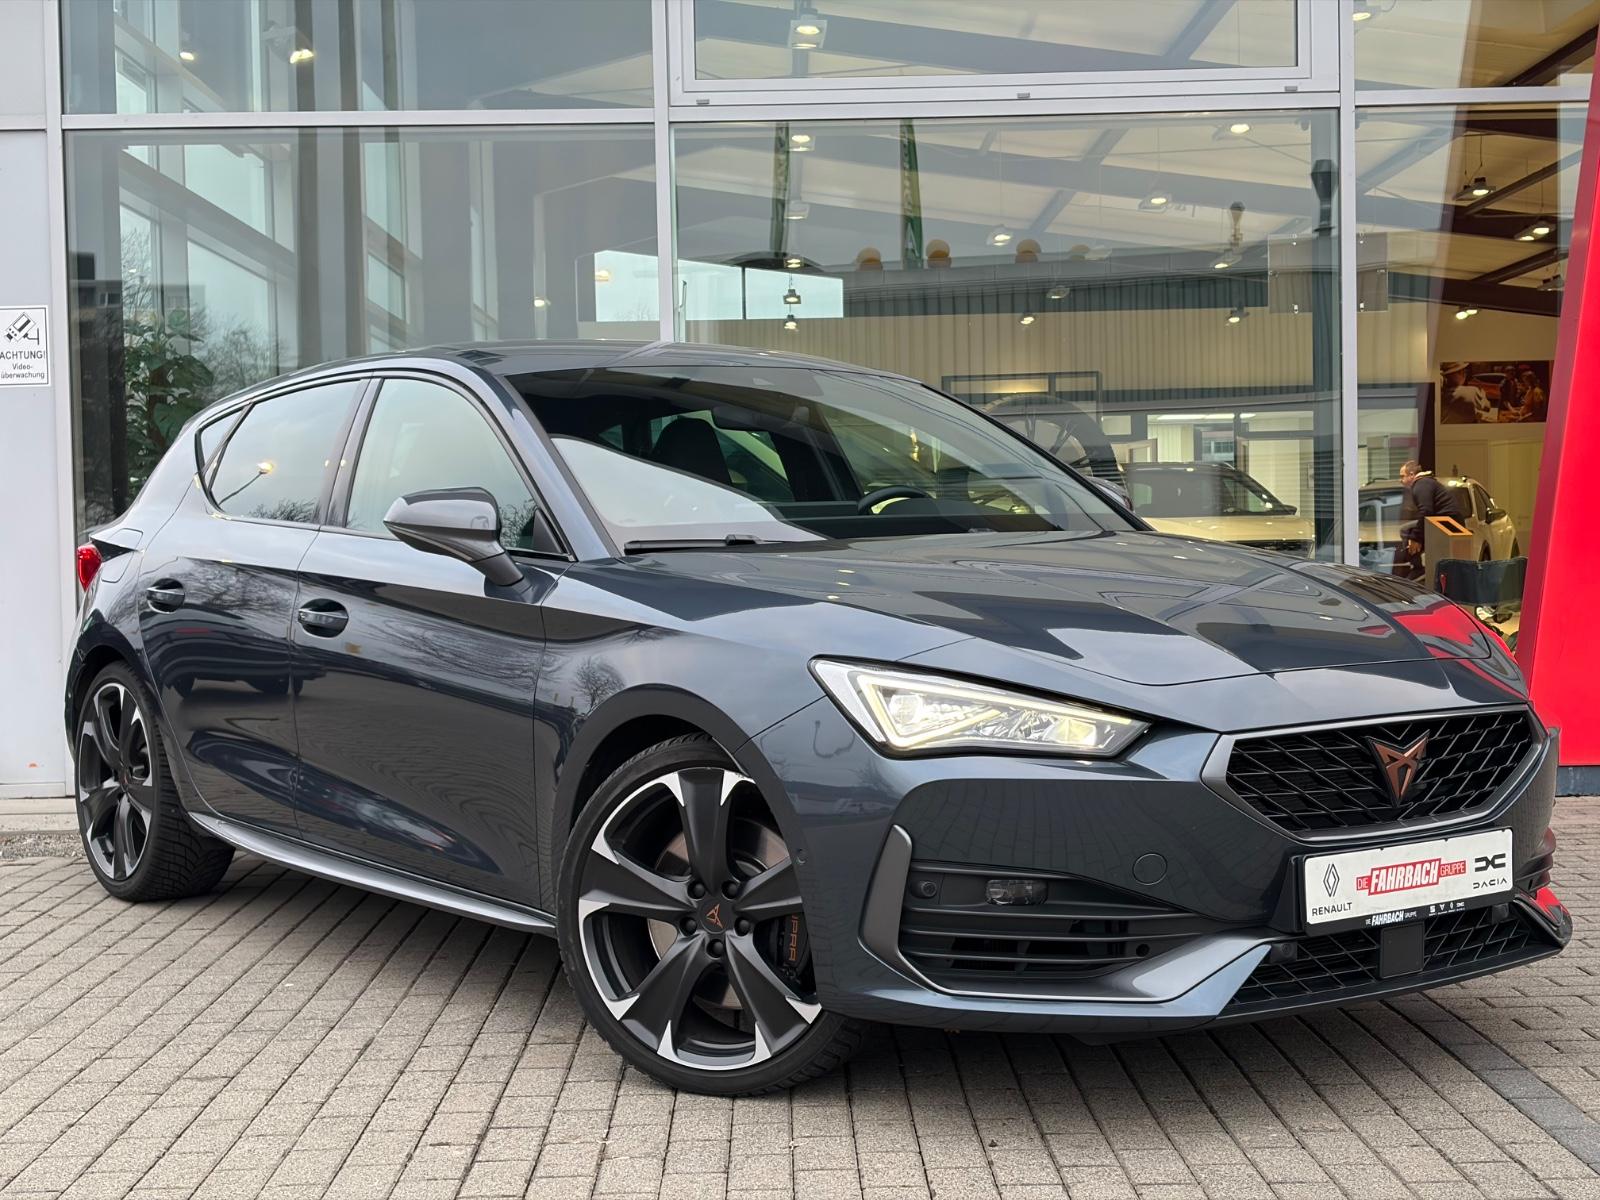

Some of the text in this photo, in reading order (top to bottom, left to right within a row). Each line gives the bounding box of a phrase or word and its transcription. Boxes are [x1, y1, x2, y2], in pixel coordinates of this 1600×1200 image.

[0, 350, 46, 360] ACHTUNG!
[1, 371, 45, 380] überwachung
[1357, 860, 1465, 893] DIE FAHRBACH GRUPPE
[1473, 877, 1507, 890] DACIA
[1312, 902, 1352, 917] RENAULT
[1371, 910, 1405, 927] FAHRBACH
